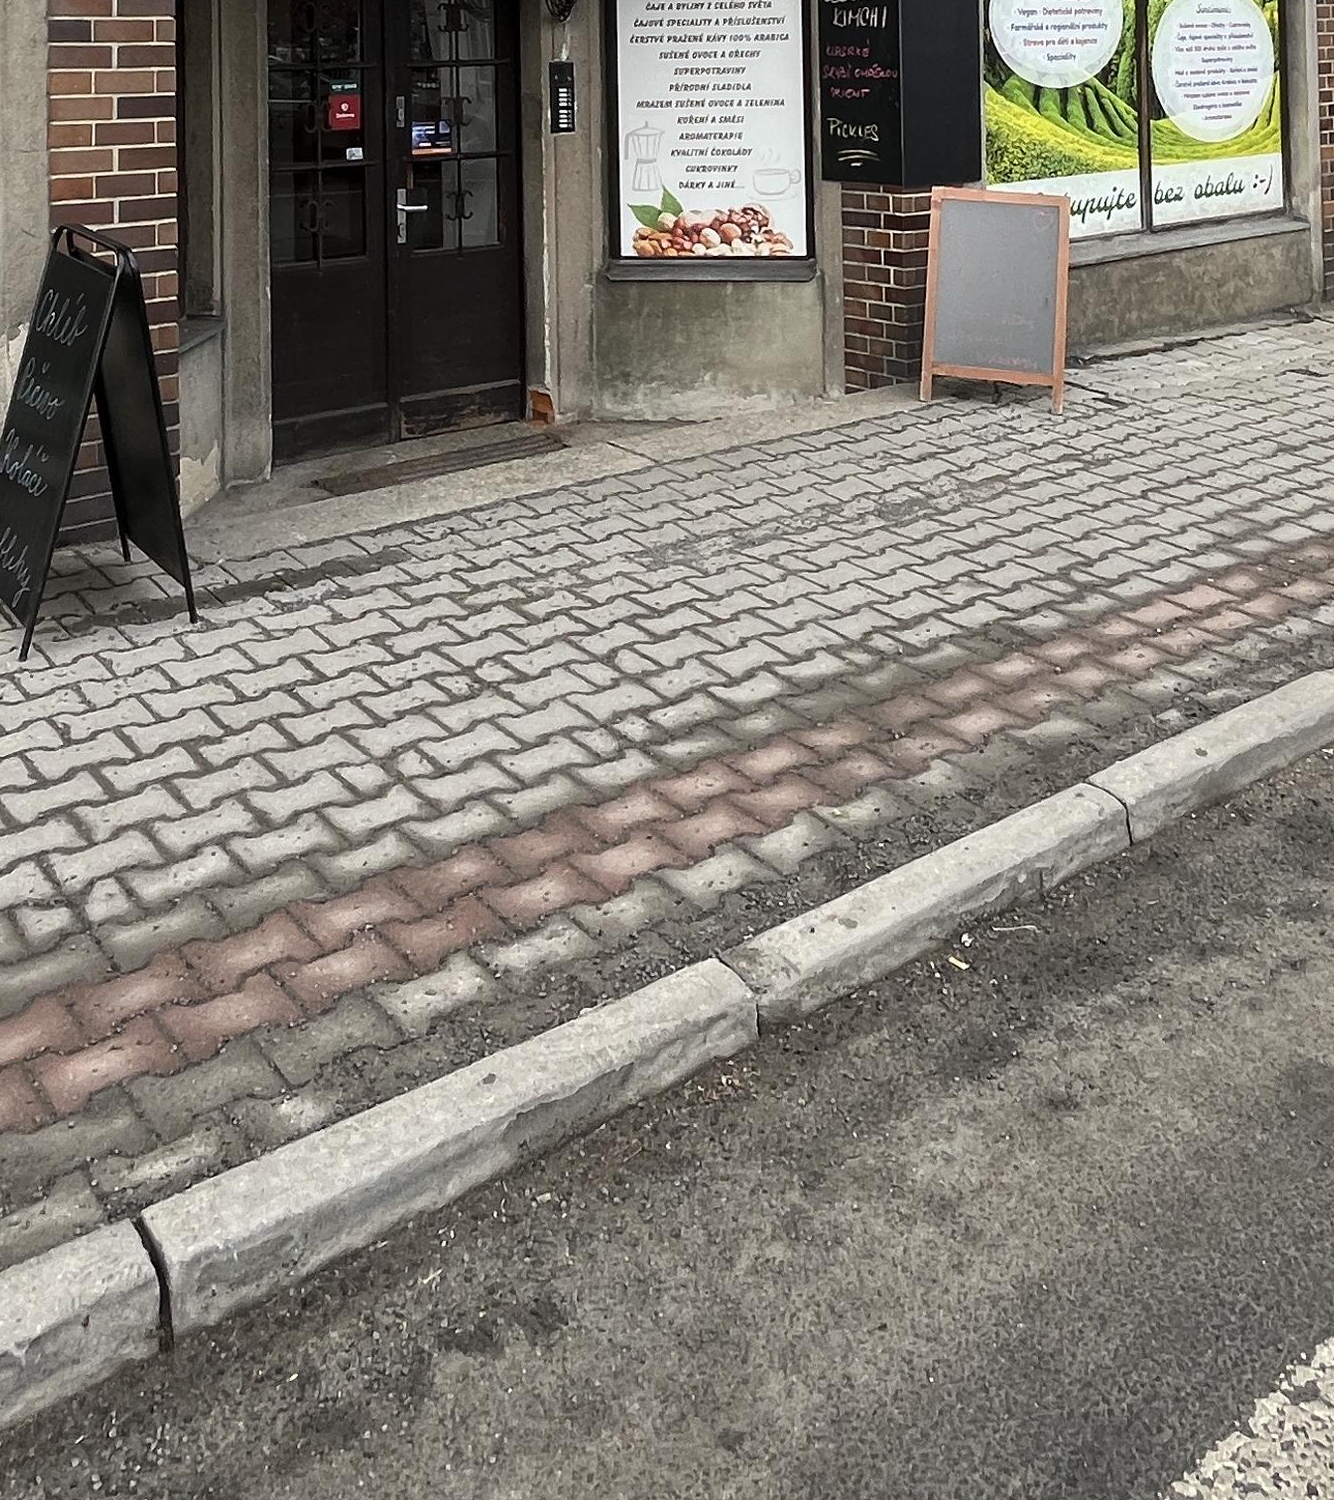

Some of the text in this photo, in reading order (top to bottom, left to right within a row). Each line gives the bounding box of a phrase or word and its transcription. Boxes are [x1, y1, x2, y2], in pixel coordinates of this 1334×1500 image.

[668, 2, 673, 10] A
[832, 5, 887, 29] KIMCHI
[667, 18, 713, 27] SPECIALITY
[754, 33, 789, 42] ARABICA
[692, 50, 718, 59] OVOCE
[720, 51, 726, 59] A
[673, 67, 747, 75] SUPERPOTRAVINY
[669, 82, 752, 92] PŘÍRODNÍ SLADIDLA
[708, 100, 734, 108] OVOCE
[745, 99, 785, 107] ZELENINA
[711, 116, 716, 124] A
[678, 132, 744, 140] AROMATERAPIE
[670, 147, 753, 157] KVALITNÍ ČOKOLÁDY
[685, 165, 738, 173] CUKROVINKY
[678, 180, 706, 189] DÁRKY
[708, 181, 714, 189] A
[1069, 186, 1138, 224] upujte
[1154, 180, 1185, 205] bez
[1194, 171, 1246, 199] obalu
